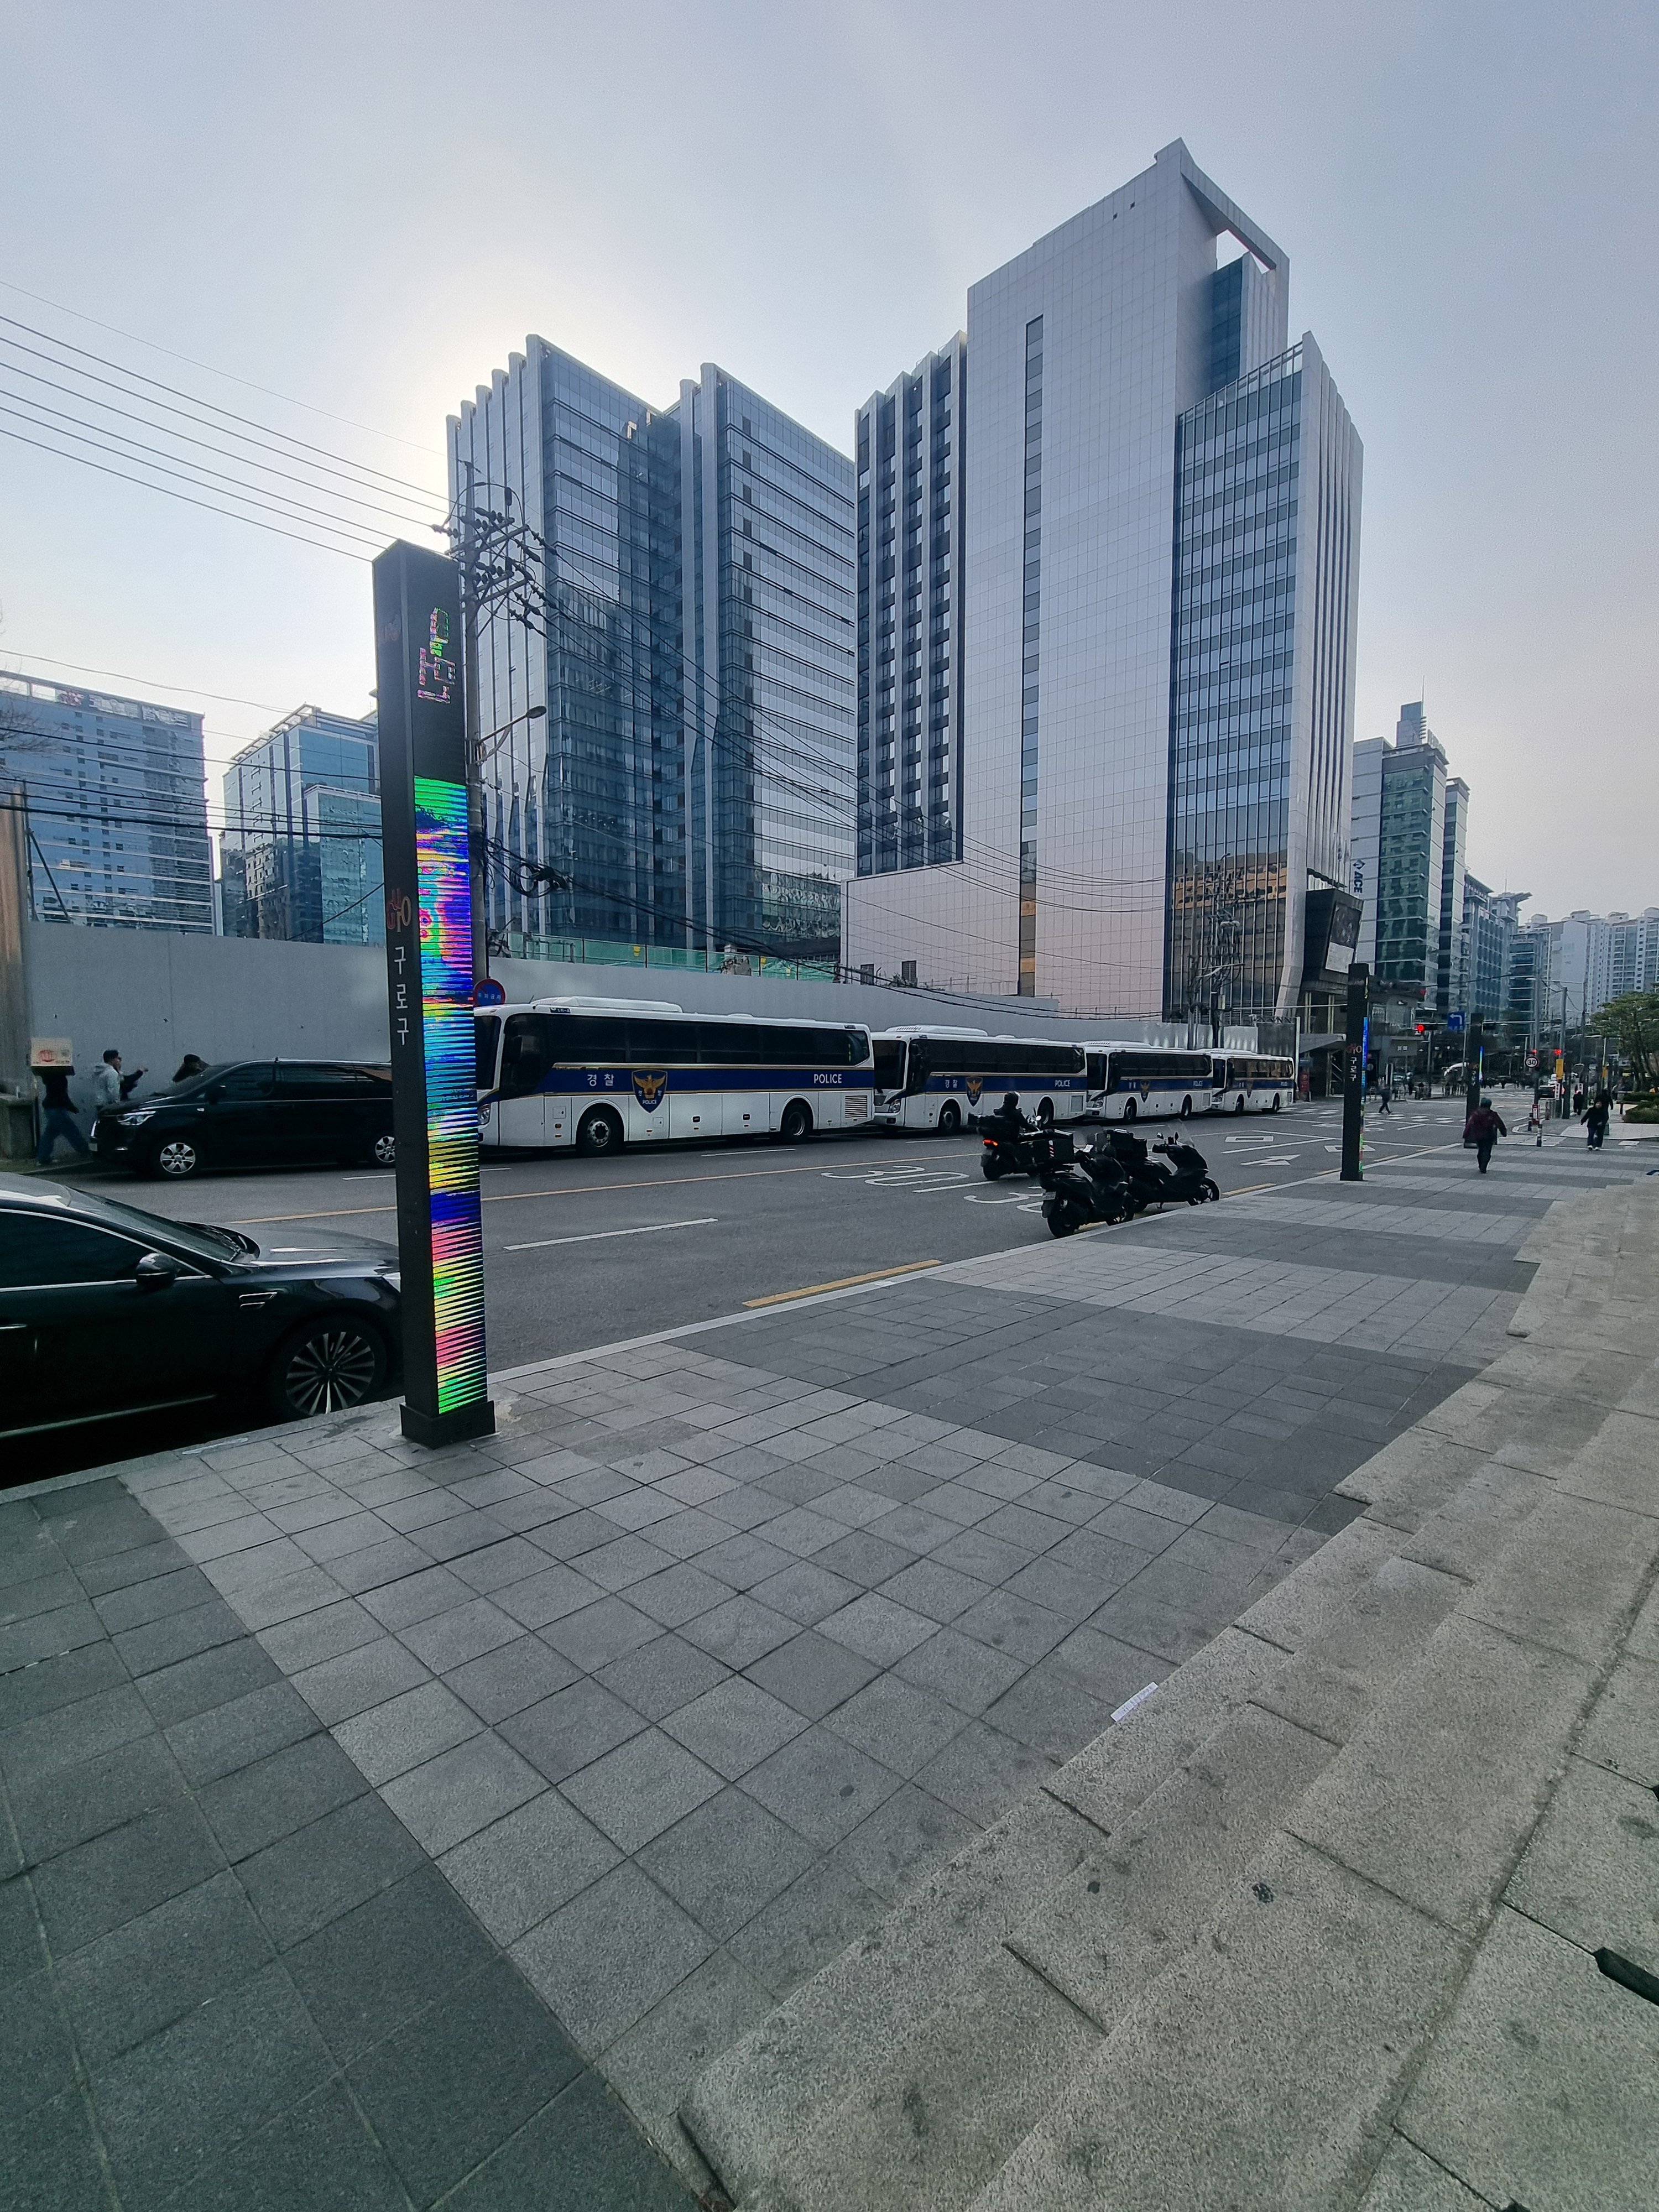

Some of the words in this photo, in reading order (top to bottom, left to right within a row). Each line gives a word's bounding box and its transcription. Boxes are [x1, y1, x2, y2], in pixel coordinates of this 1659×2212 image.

[1354, 871, 1363, 893] ACE
[394, 946, 409, 1046] 구로구
[587, 1073, 615, 1087] 경찰
[813, 1073, 842, 1084] POLICE
